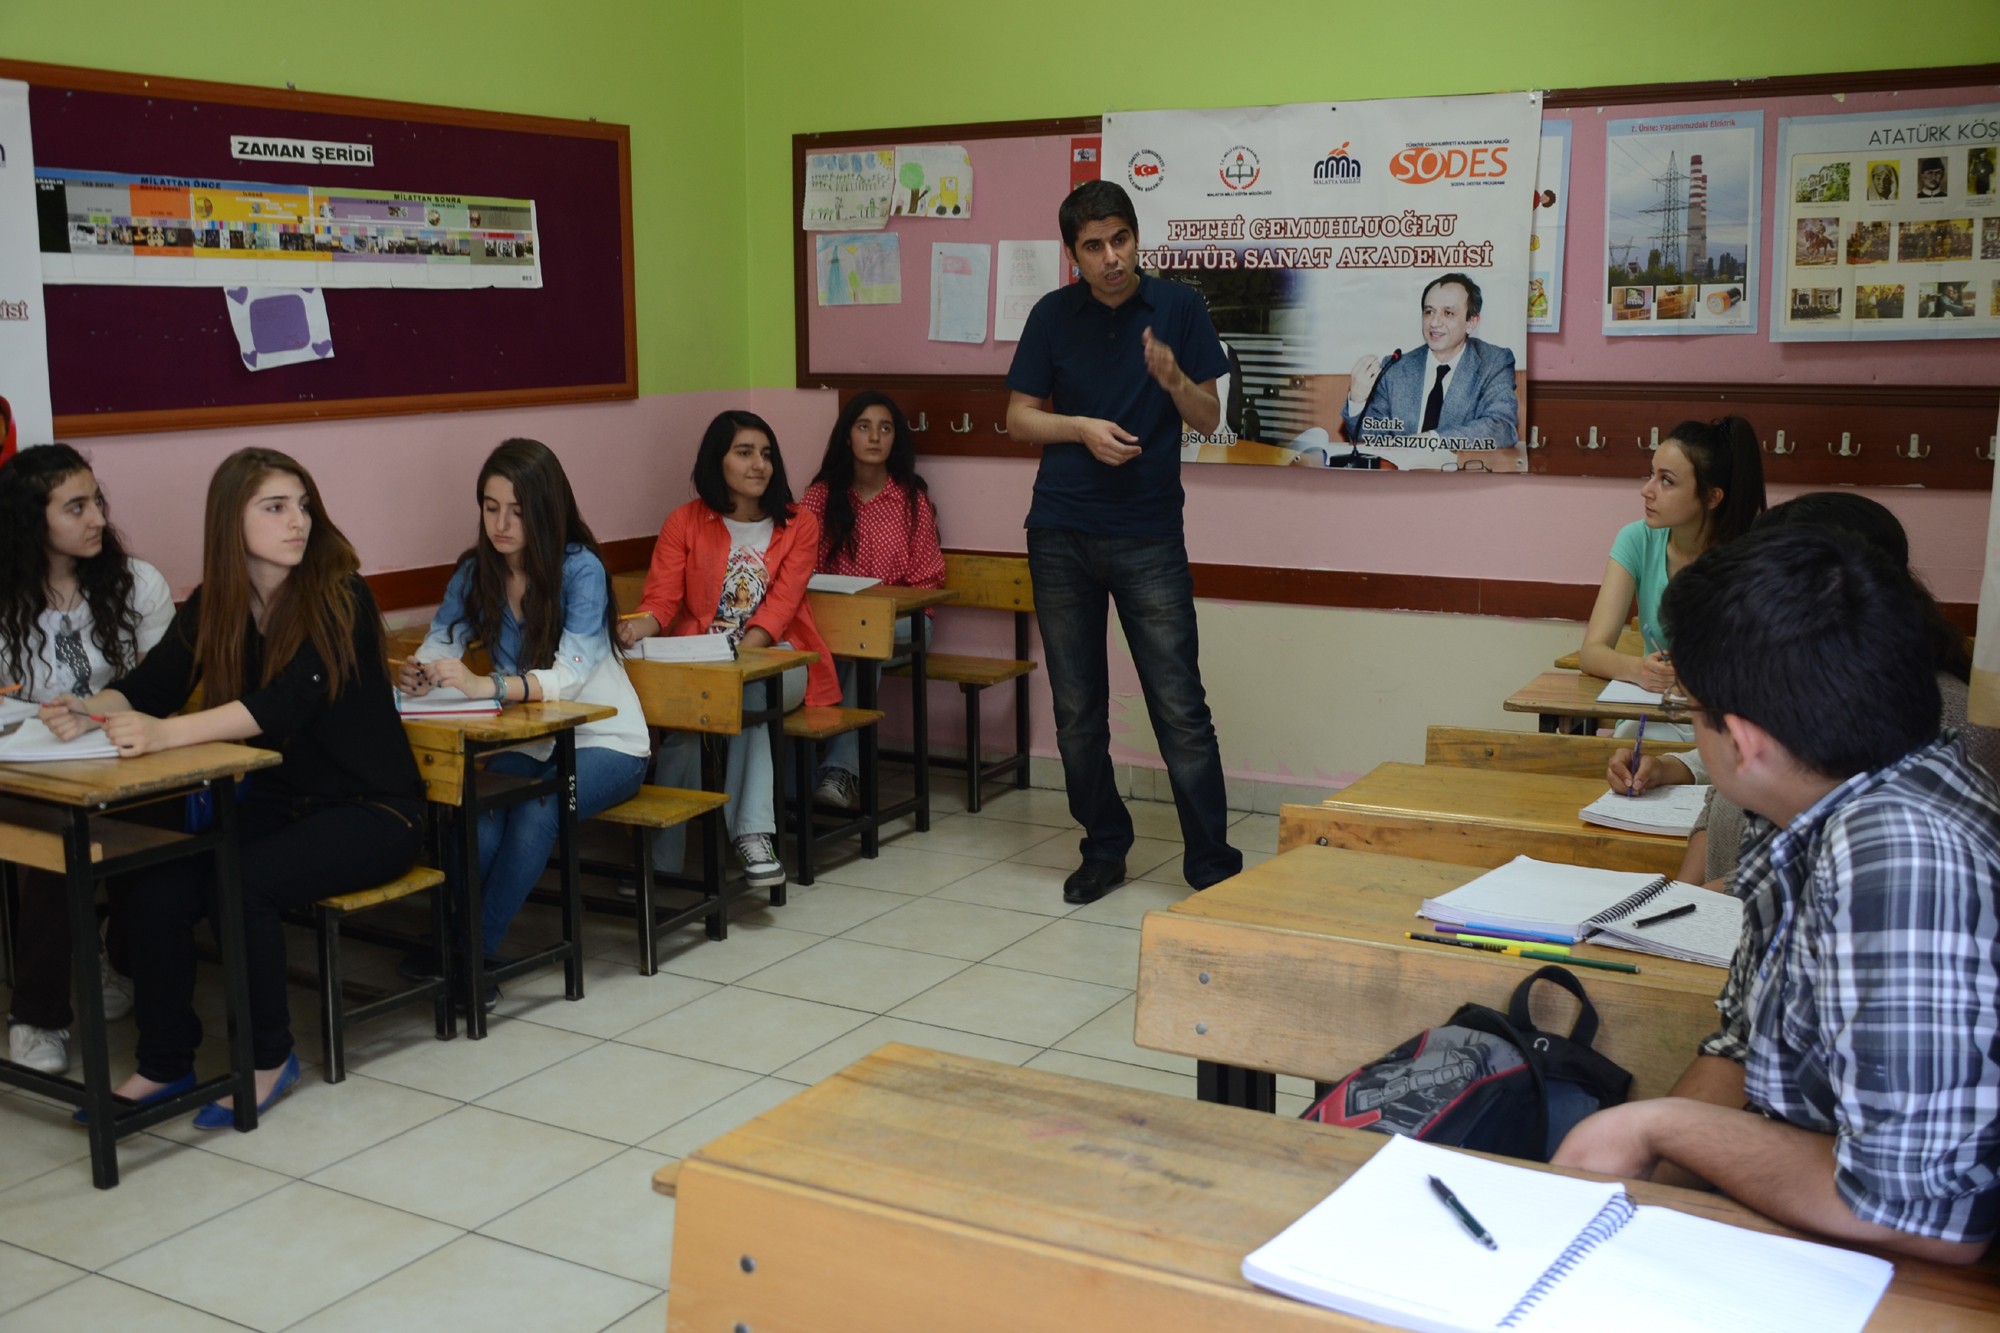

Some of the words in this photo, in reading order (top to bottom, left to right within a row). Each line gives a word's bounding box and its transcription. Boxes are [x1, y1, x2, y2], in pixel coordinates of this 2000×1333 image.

[1868, 123, 1951, 145] ATATÜRK
[1957, 118, 2000, 141] KÖŞ
[237, 141, 305, 159] ZAMAN
[312, 145, 372, 164] ŞERİDİ
[1395, 146, 1509, 180] SODES
[140, 176, 191, 187] MİLATTAN
[193, 179, 221, 189] ÖNCE
[393, 193, 432, 203] MİLATTAN
[434, 195, 462, 204] SONRA
[1168, 214, 1245, 241] FETHİ
[1249, 210, 1457, 240] GEMUHLUOĞLU
[1137, 244, 1238, 270] KÜLTÜR
[1243, 247, 1332, 270] SANAT
[1336, 240, 1494, 269] AKADEMİSİ
[1362, 417, 1404, 431] Sadık
[1180, 432, 1238, 445] OSOGLU
[1361, 434, 1497, 452] YALSIZUÇANLAR
